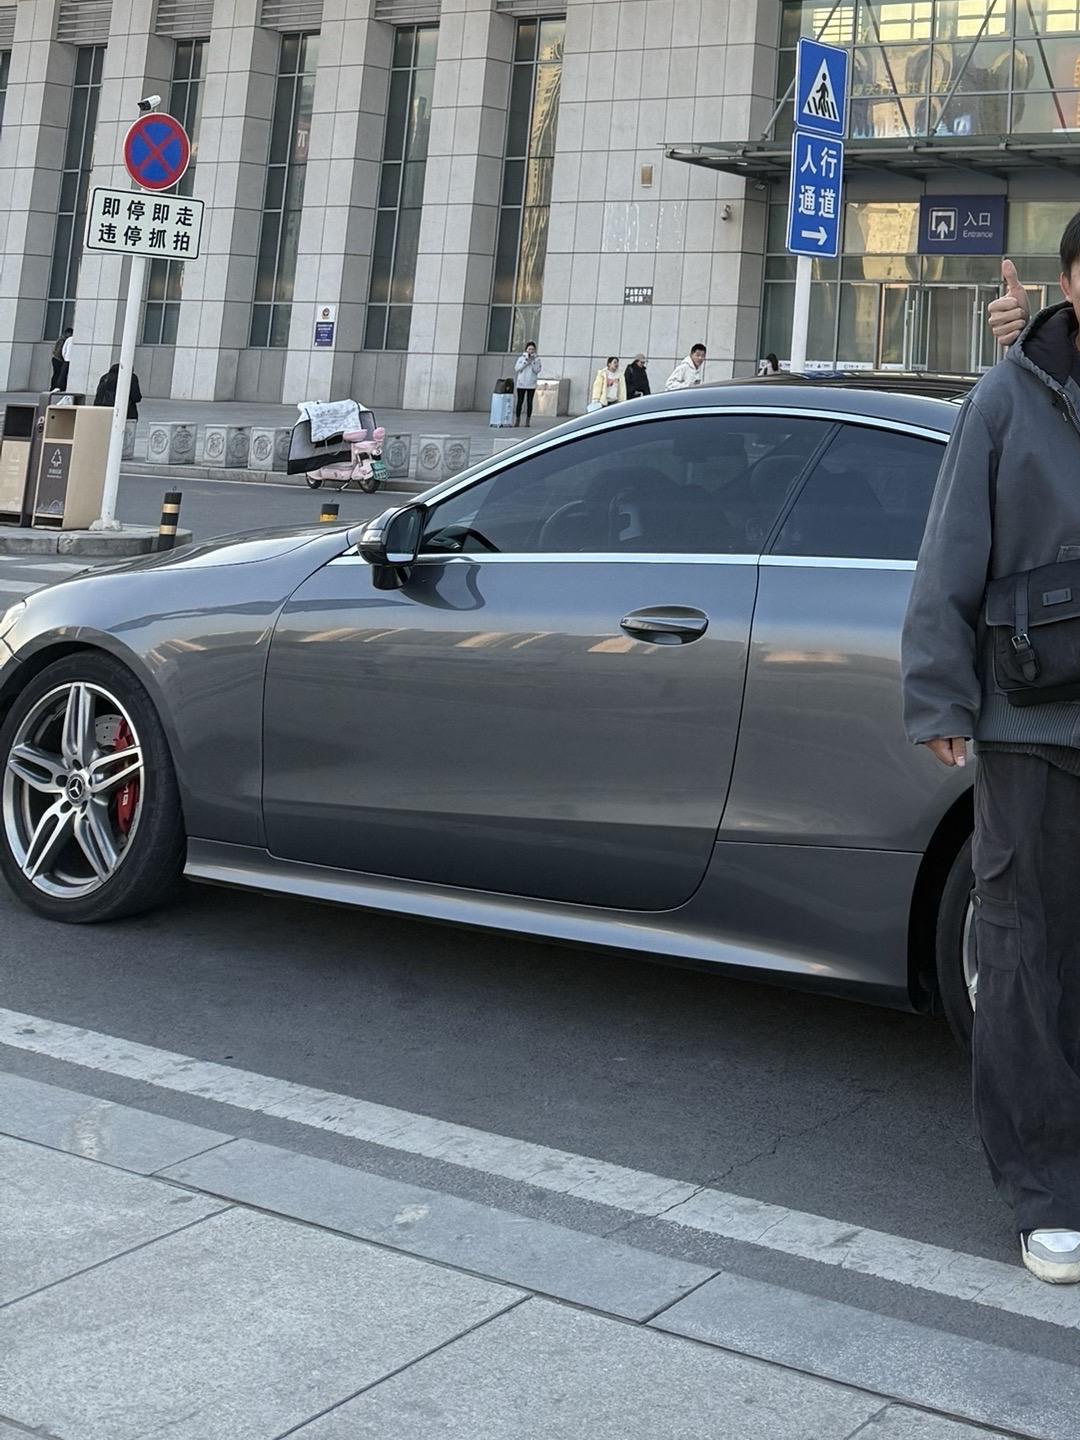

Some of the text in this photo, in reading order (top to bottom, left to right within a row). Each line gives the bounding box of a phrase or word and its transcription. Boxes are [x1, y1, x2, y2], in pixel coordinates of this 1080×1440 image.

[800, 144, 837, 178] 人行
[102, 197, 193, 227] 即停即走
[798, 184, 836, 218] 通道
[962, 230, 993, 238] Entrance
[963, 211, 991, 227] 入口
[98, 222, 190, 252] 违停抓拍
